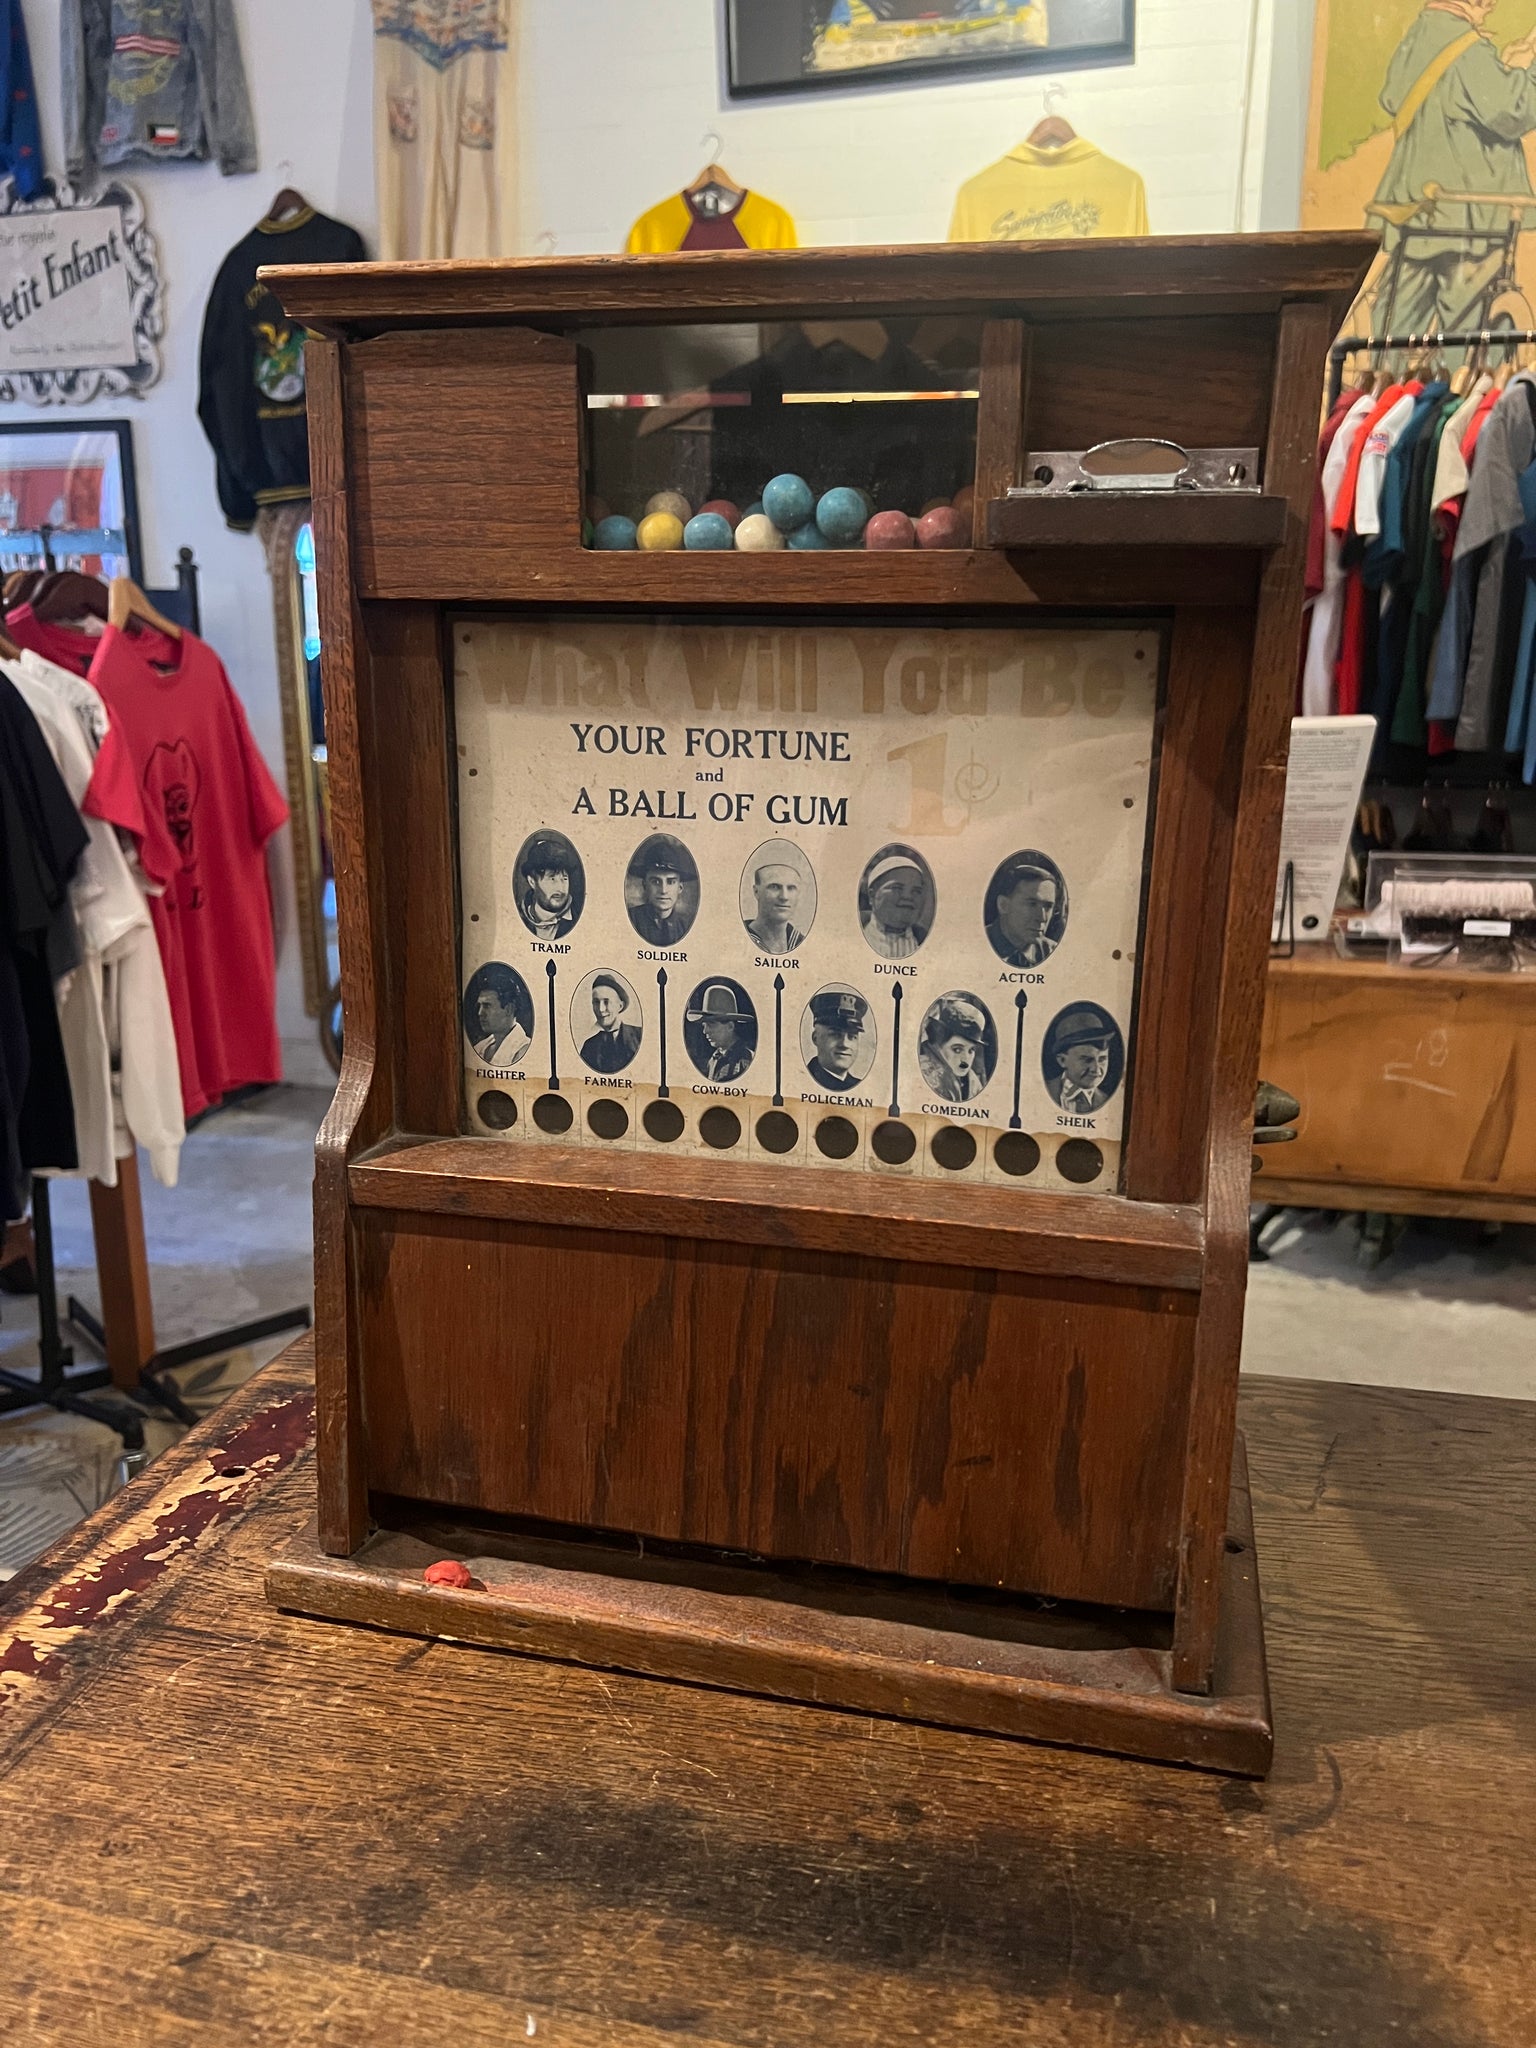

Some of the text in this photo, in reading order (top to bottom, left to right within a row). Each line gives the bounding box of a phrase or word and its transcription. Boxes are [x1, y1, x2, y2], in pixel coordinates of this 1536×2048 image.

[0, 229, 121, 331] etit Enfant
[471, 630, 1126, 718] What Will You Be
[569, 723, 851, 762] YOUR FORTUNE
[695, 767, 724, 782] and
[571, 787, 849, 827] A BALL OF GUM
[529, 941, 572, 955] TRAMP
[636, 950, 689, 963] SOLDIER
[753, 957, 801, 970] SAILOR
[873, 963, 918, 976] DUNCE
[998, 972, 1045, 985] ACTOR
[475, 1068, 527, 1082] FIGHTER
[583, 1076, 634, 1089] FARMER
[691, 1084, 749, 1098] COW-BOY
[800, 1093, 874, 1108] POLICEMAN
[920, 1103, 991, 1119] COMEDIAN
[1055, 1114, 1097, 1129] SHEIK
